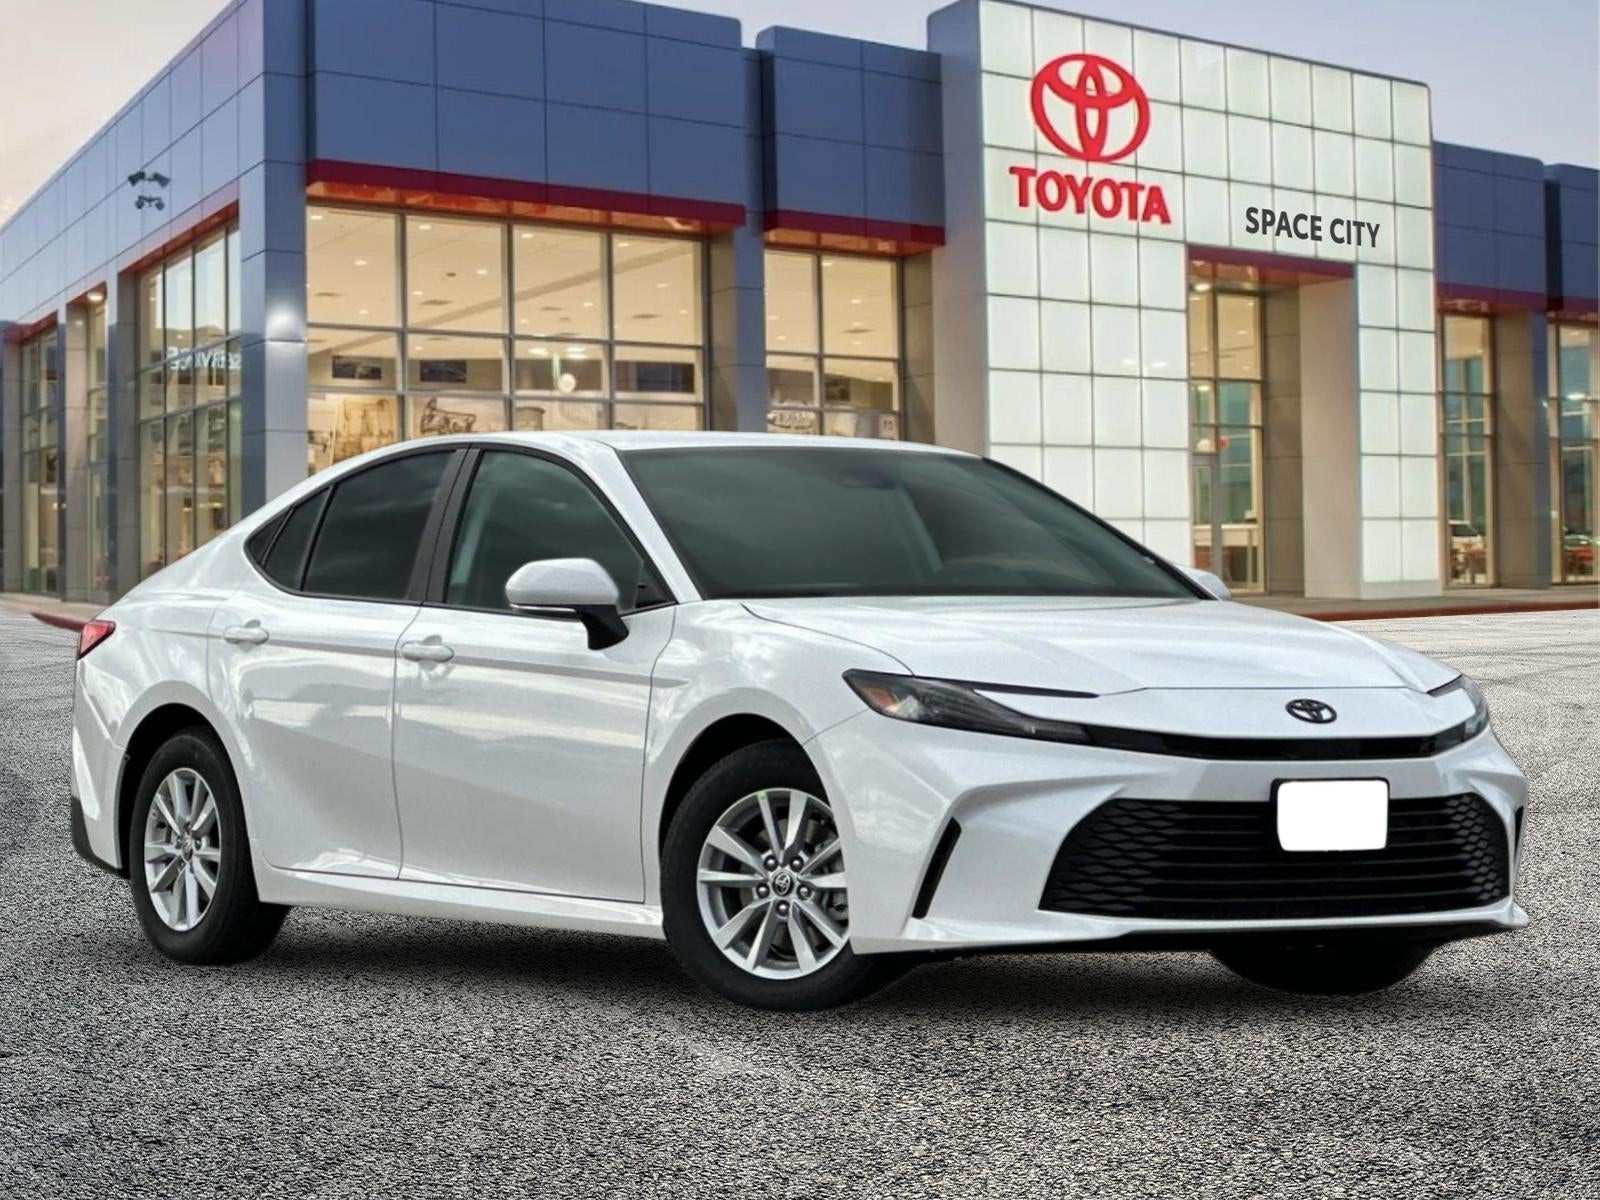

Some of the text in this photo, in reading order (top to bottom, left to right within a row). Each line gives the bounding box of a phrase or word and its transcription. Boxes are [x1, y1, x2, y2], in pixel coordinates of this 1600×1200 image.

[1009, 166, 1171, 225] TOYOTA
[1245, 206, 1381, 248] SPACE CITY
